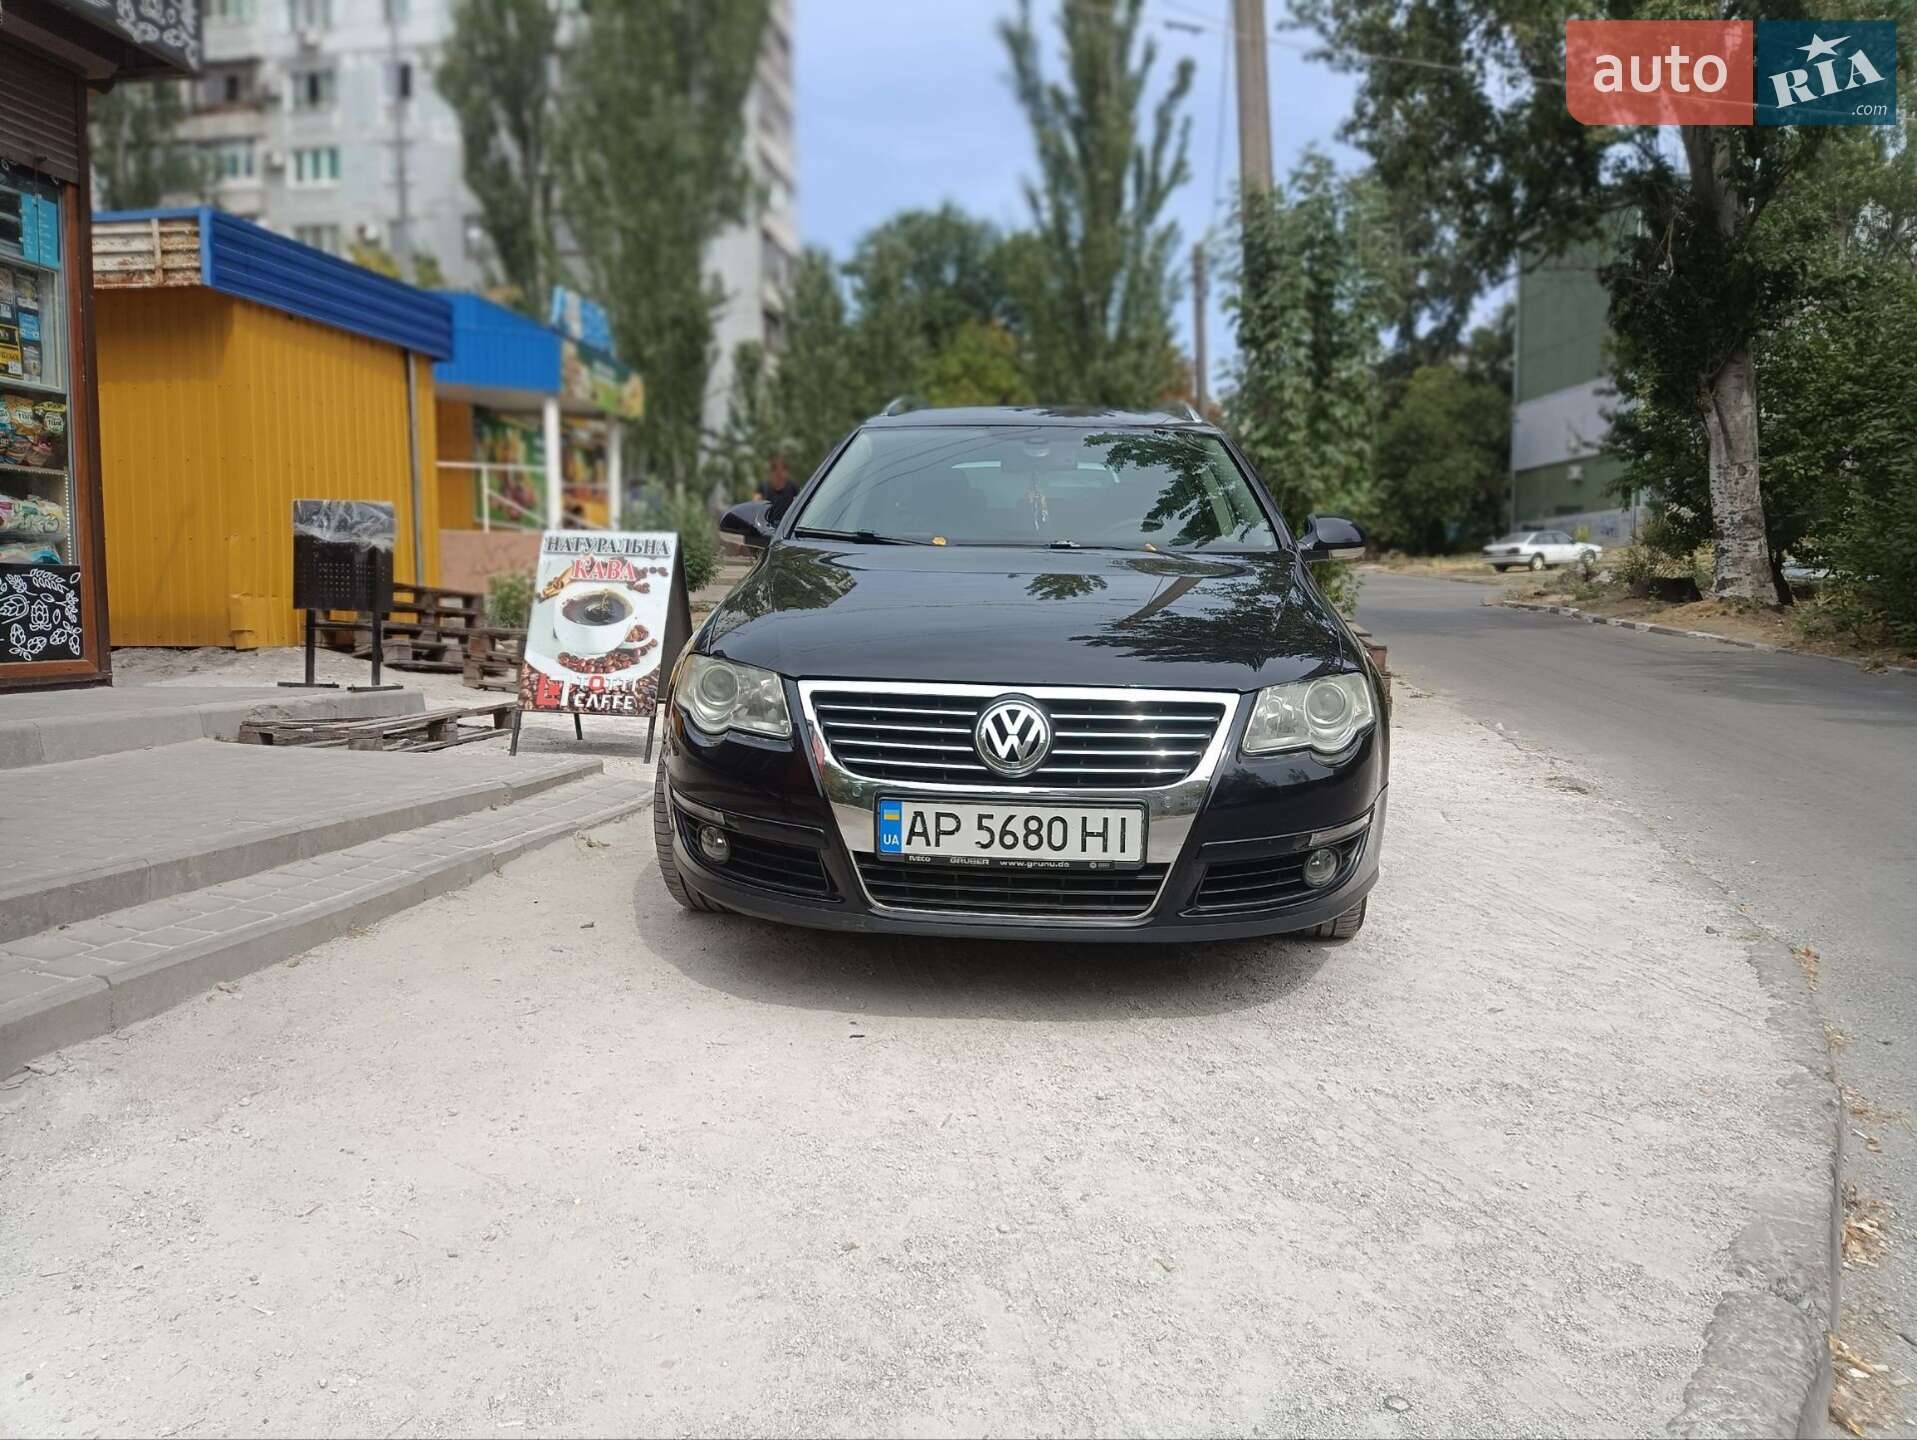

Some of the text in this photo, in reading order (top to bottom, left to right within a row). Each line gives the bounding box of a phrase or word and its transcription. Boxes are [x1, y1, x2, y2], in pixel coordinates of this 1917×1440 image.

[546, 536, 670, 555] НАТУРАЛЬНА
[572, 558, 637, 581] КАВА
[573, 693, 636, 710] CAFFE
[883, 833, 900, 846] UA
[905, 811, 1127, 853] AP 5680 HI
